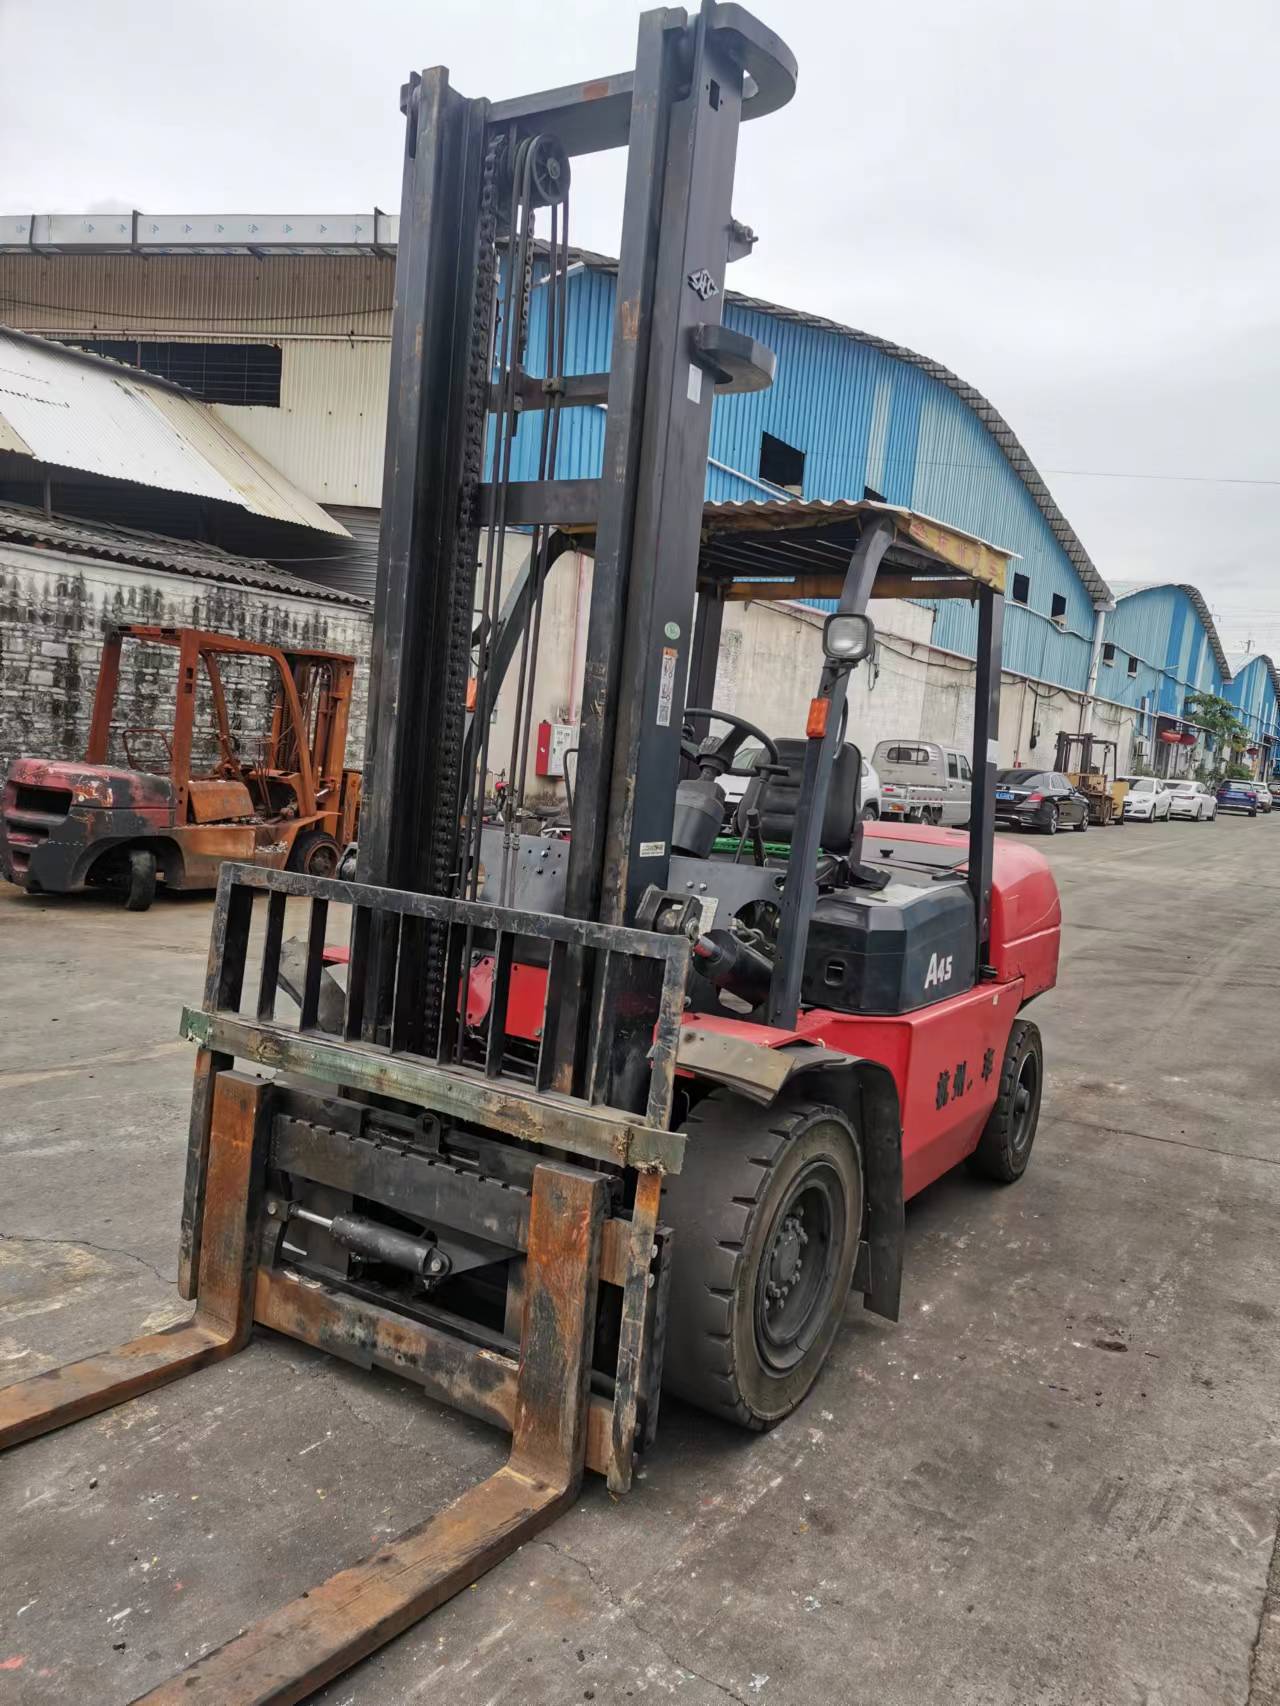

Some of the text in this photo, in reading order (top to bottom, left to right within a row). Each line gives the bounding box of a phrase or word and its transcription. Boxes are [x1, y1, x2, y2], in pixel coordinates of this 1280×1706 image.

[924, 952, 953, 989] A45
[935, 1047, 995, 1111] 杭州车
